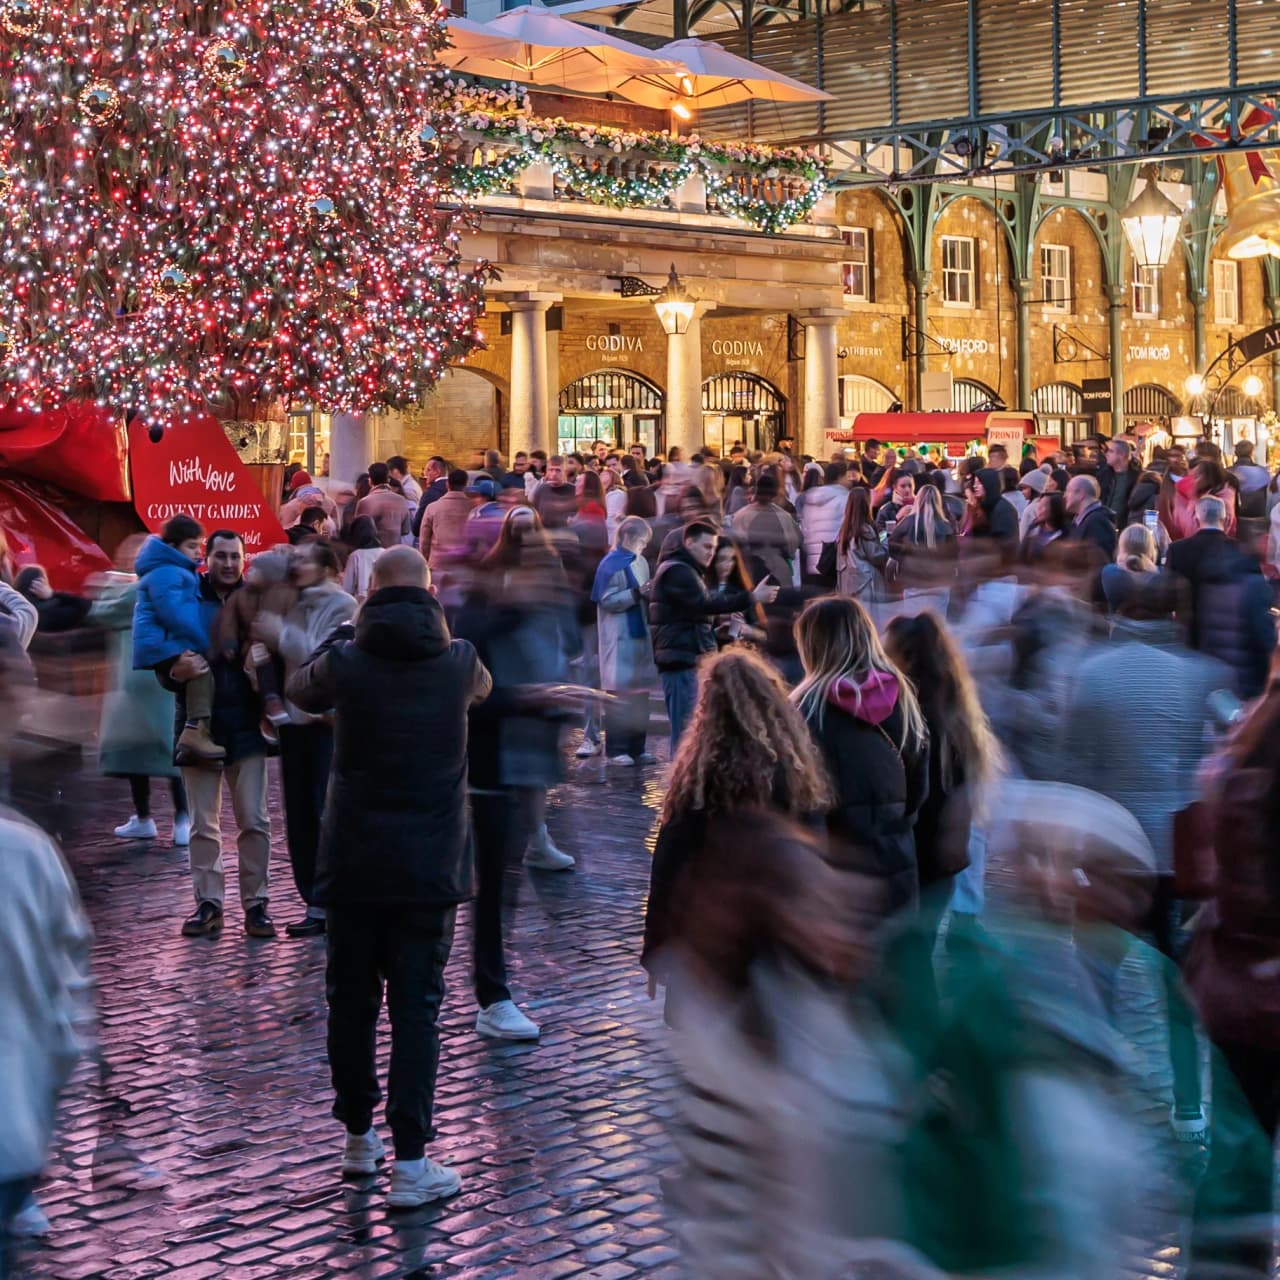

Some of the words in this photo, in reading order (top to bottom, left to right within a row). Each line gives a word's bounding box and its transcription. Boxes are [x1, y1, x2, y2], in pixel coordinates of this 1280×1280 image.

[586, 334, 644, 352] GODIVA
[712, 339, 764, 357] GODIVA
[937, 337, 961, 353] TOM
[961, 337, 988, 353] FORD
[1129, 346, 1147, 360] TOM
[1148, 345, 1170, 360] FORD
[1083, 392, 1095, 400] TOM
[1095, 391, 1111, 399] FORD
[825, 431, 850, 440] PRONT
[990, 431, 1020, 439] PRONTO
[169, 456, 206, 487] With
[205, 464, 236, 492] love
[147, 503, 205, 519] COVENT
[207, 503, 261, 519] GARDEN
